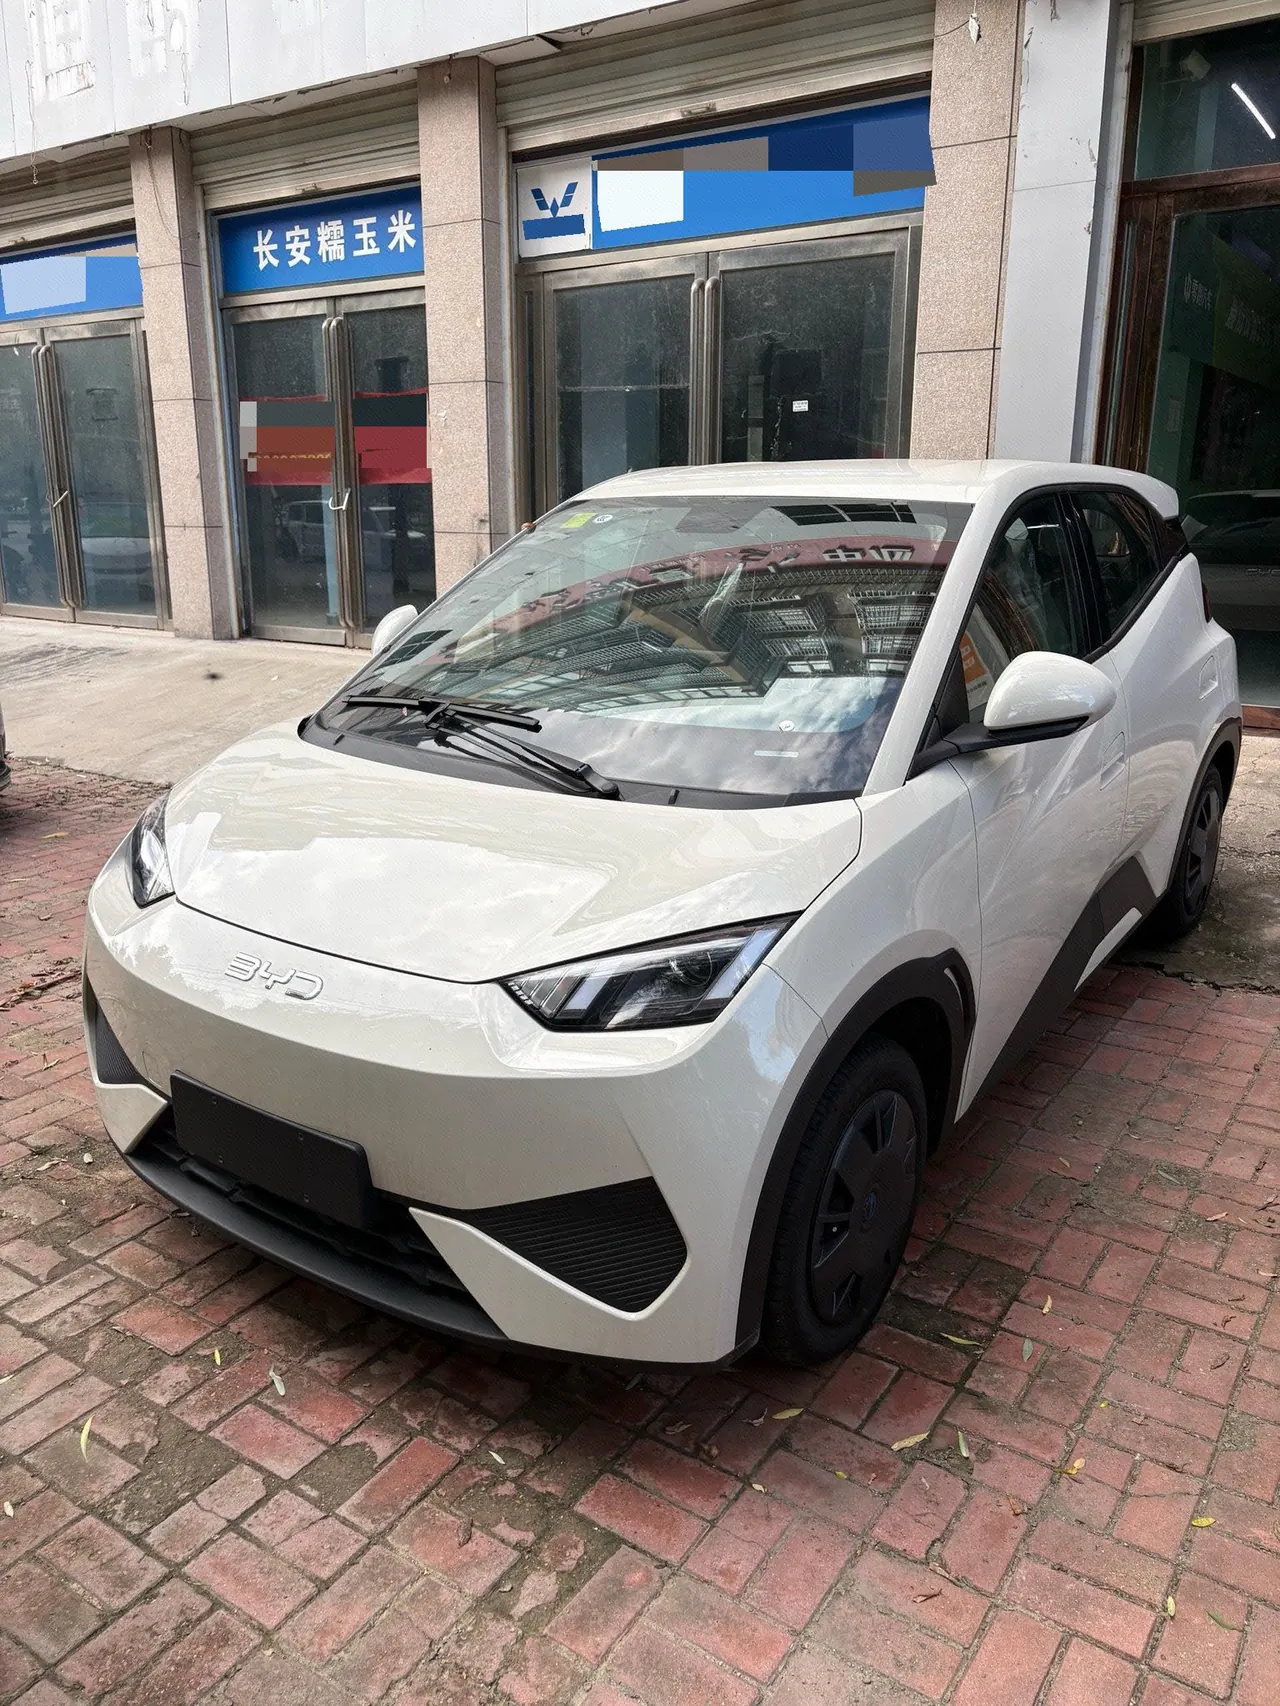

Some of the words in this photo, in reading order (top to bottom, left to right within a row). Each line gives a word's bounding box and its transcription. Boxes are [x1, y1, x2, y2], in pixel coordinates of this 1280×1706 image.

[253, 210, 417, 271] 长安糯玉米
[224, 952, 324, 1000] BYD
